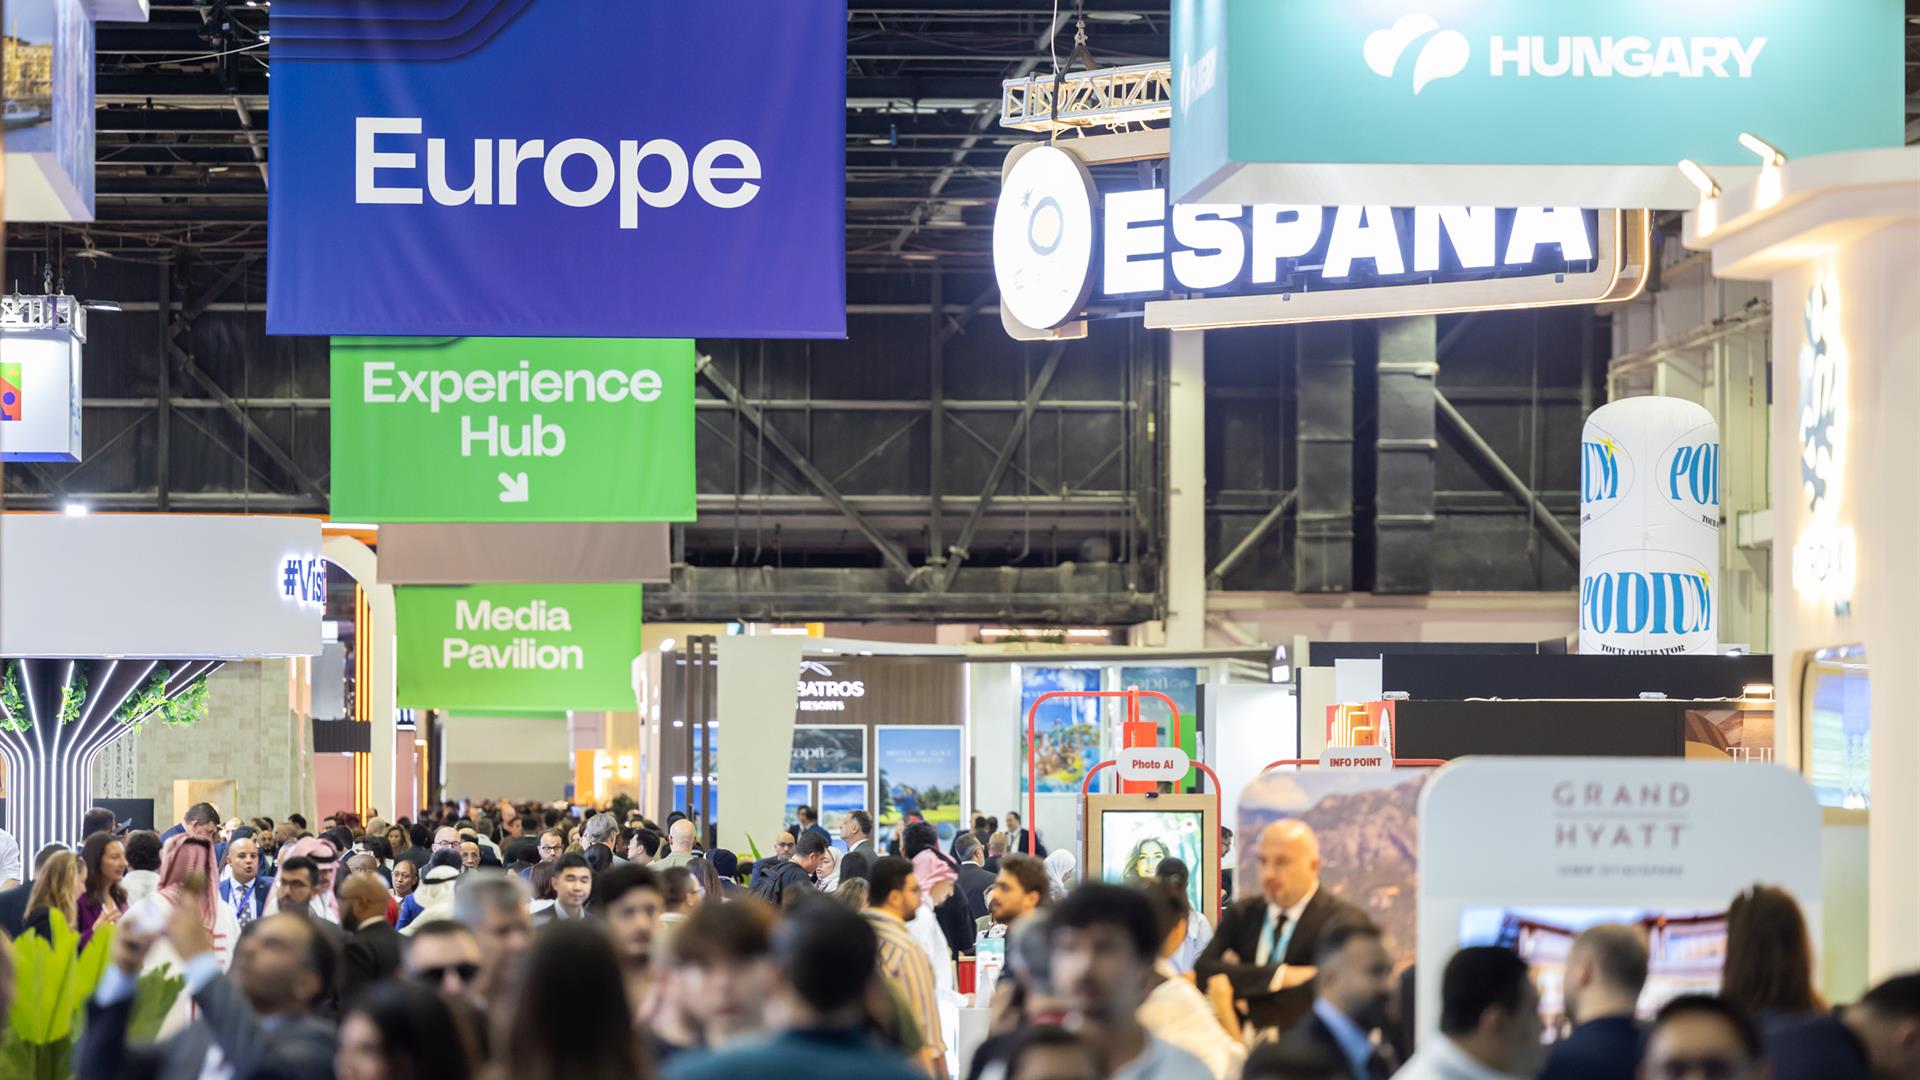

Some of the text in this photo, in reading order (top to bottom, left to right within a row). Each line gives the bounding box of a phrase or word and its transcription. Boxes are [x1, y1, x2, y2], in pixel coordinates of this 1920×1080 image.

[1489, 35, 1767, 79] HUNGARY
[355, 116, 762, 229] Europe
[363, 359, 663, 413] Experience
[460, 413, 567, 458] Hub
[455, 599, 572, 632] Media
[1581, 571, 1711, 636] PODIUM
[443, 637, 585, 671] Pavilion
[1600, 643, 1625, 655] TOUR
[1132, 759, 1174, 769] Photo AI
[1329, 757, 1382, 768] INFO POINT
[1552, 780, 1691, 808] GRAND
[1554, 822, 1689, 848] HYATT
